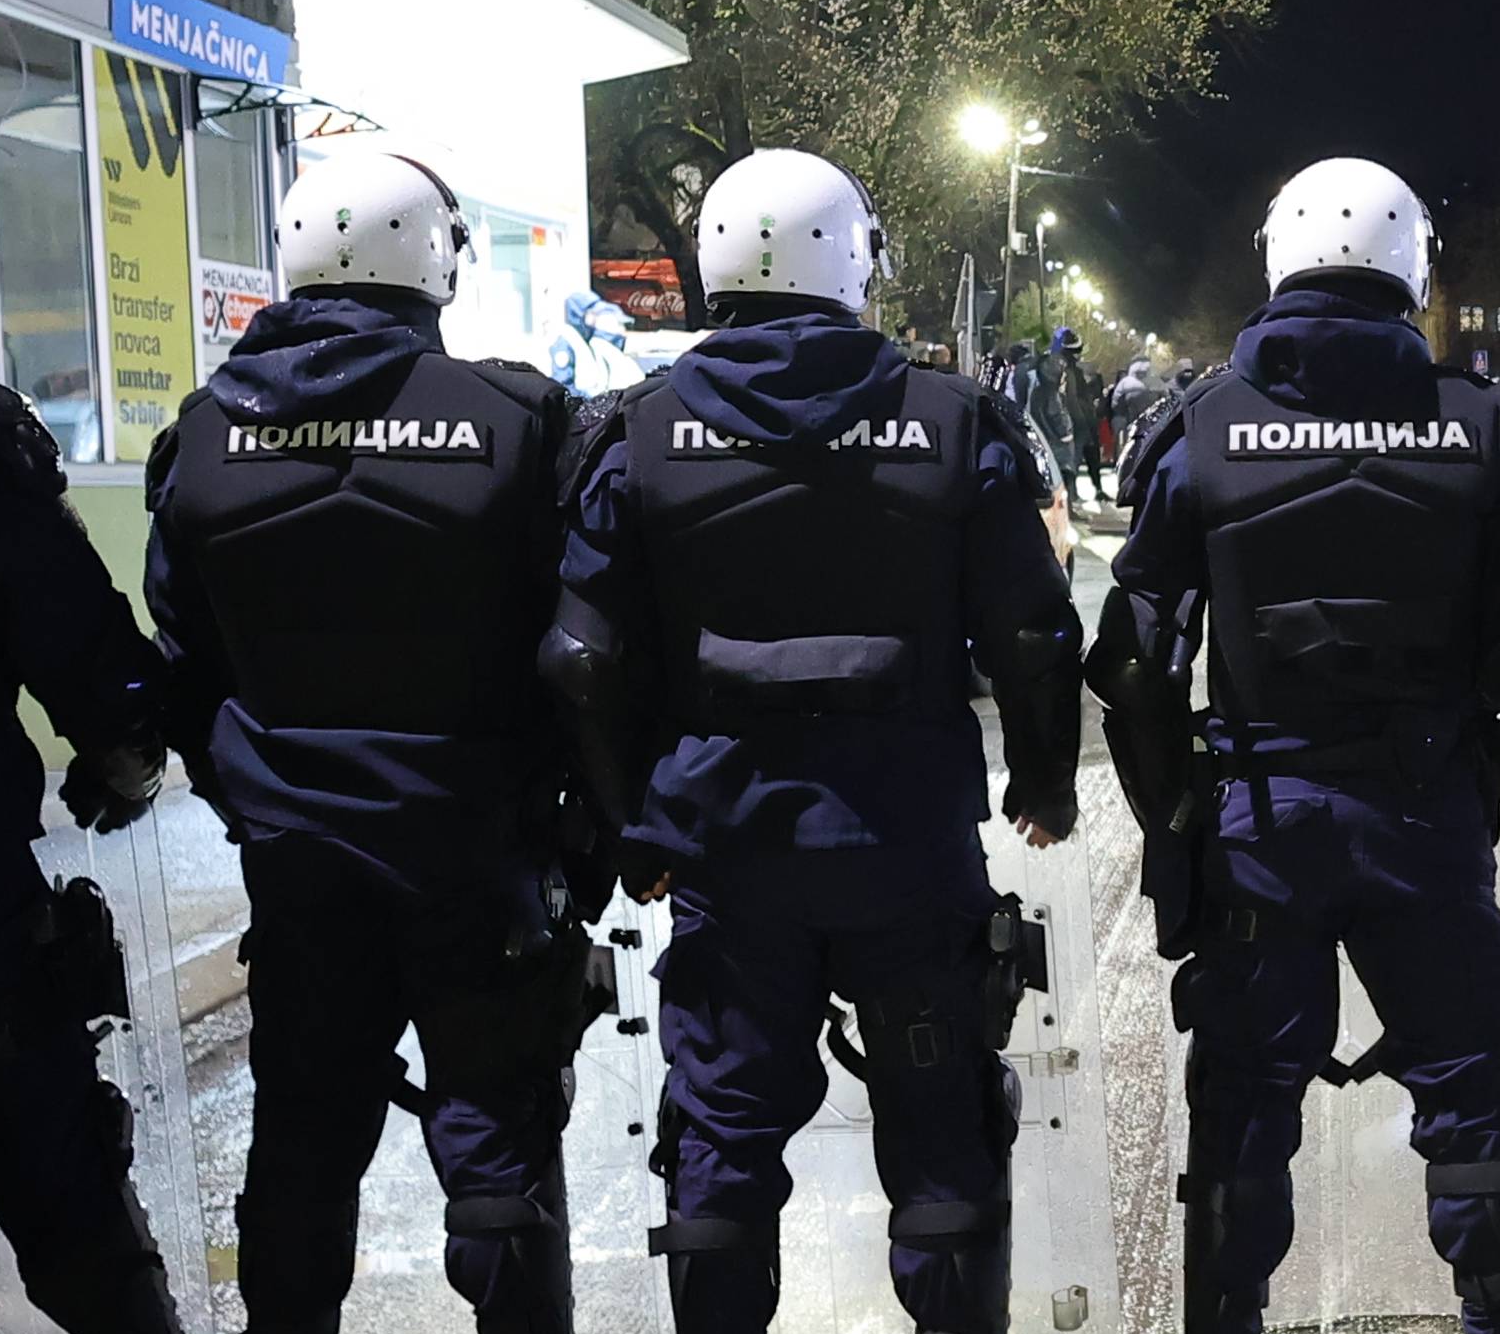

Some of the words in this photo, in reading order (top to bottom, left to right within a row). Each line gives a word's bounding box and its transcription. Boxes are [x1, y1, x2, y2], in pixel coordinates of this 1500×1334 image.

[110, 253, 140, 283] Brzi
[112, 293, 174, 322] transfer
[115, 332, 161, 357] novca
[227, 419, 481, 454] ПОЛИЦИЈА
[1228, 420, 1471, 454] ПОЛИЦИЈА
